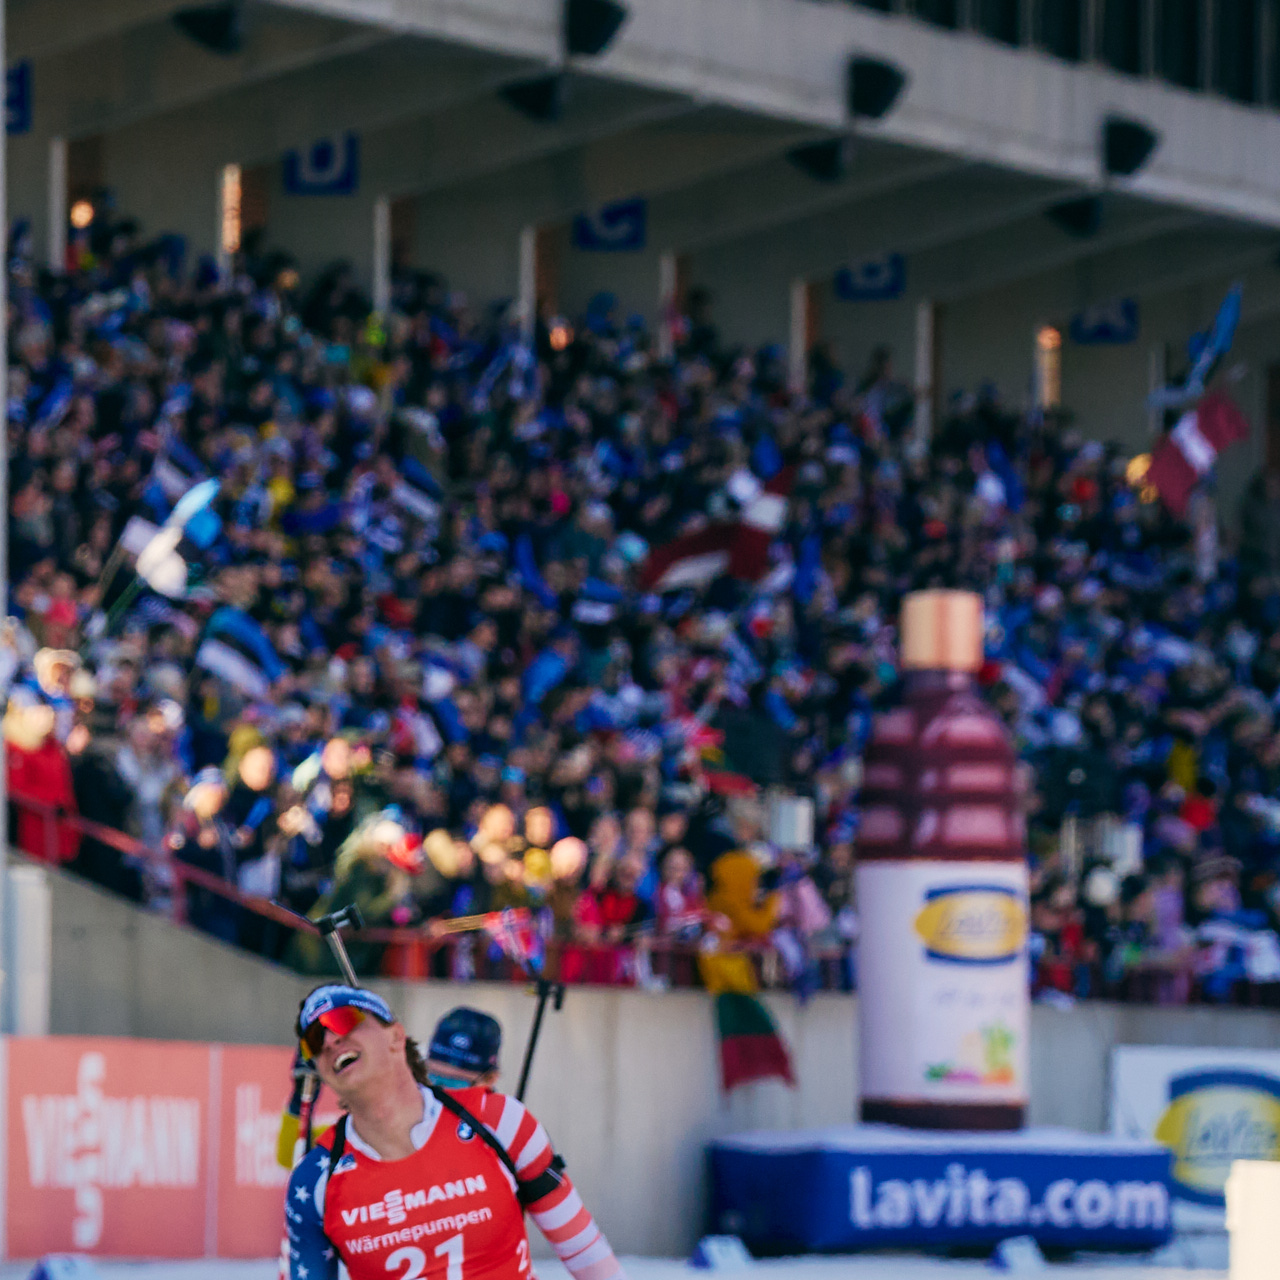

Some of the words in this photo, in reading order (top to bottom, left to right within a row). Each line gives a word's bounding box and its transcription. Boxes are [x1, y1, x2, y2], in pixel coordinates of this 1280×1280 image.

[341, 1174, 487, 1226] VIESSMANN
[848, 1161, 1169, 1230] Lavita.com
[345, 1207, 492, 1255] Wärmepumpen
